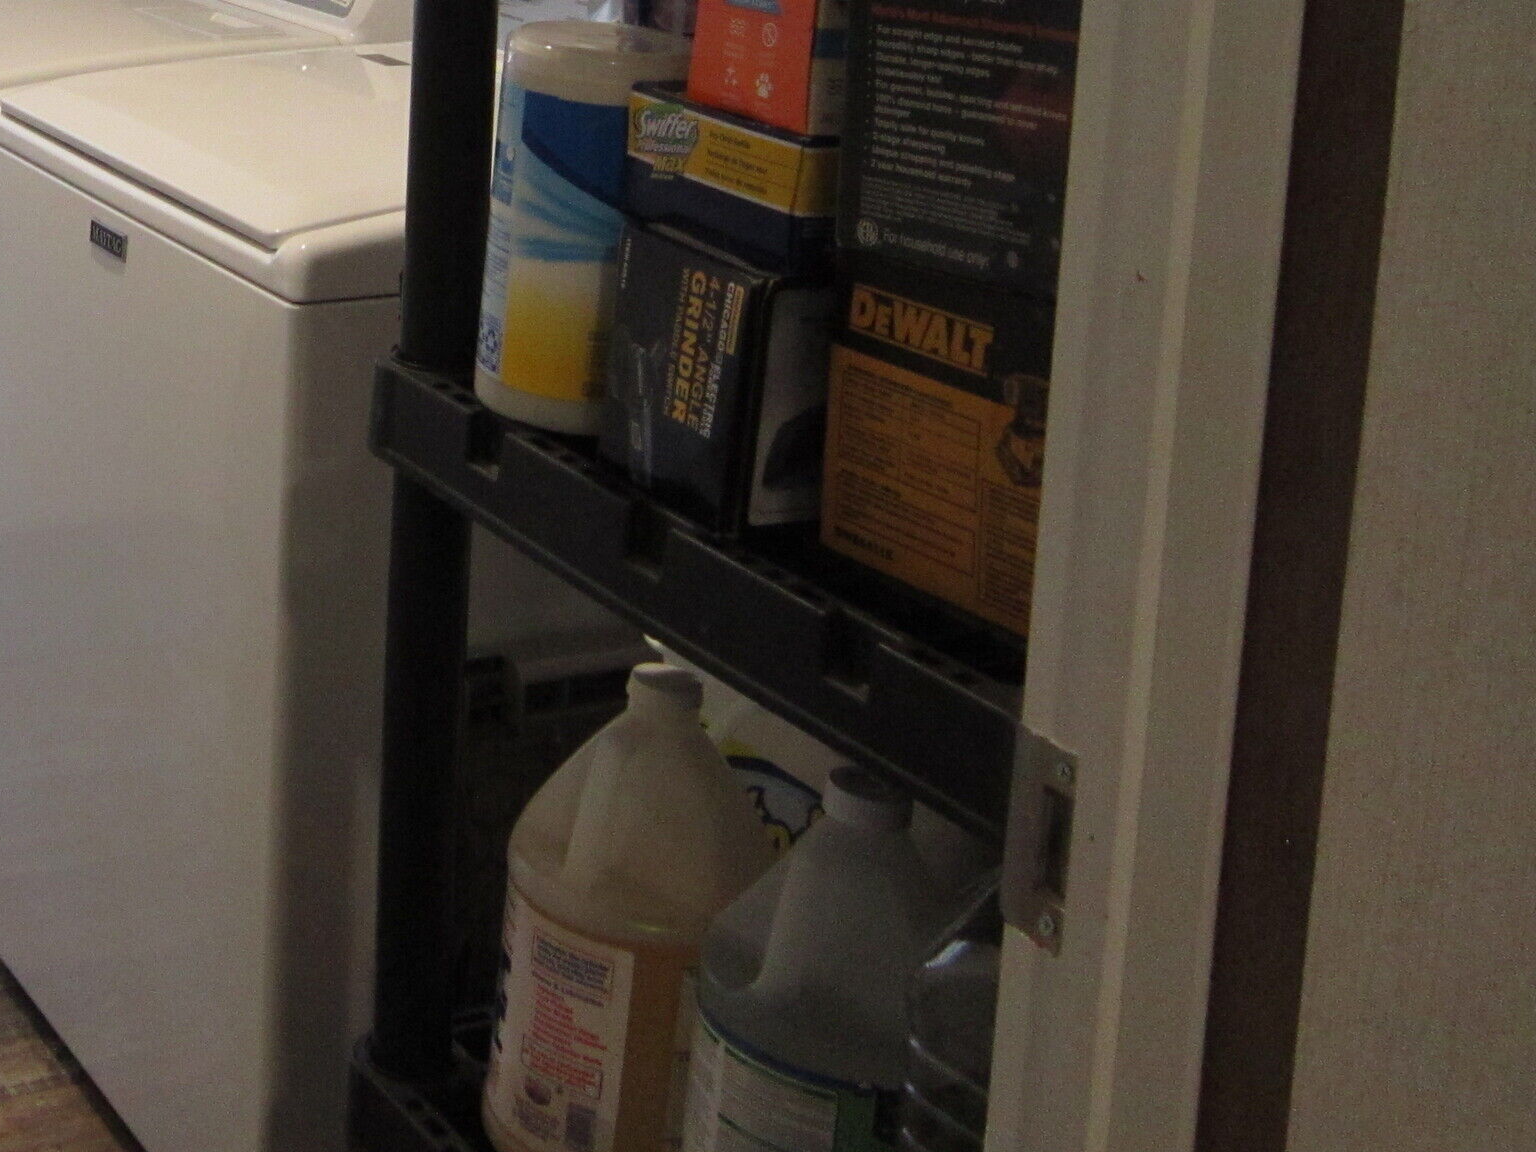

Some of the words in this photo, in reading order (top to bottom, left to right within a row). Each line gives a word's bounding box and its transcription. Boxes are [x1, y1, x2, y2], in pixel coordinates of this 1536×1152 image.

[636, 109, 698, 139] Swiffer
[883, 228, 897, 244] For
[899, 233, 946, 256] household
[671, 270, 707, 424] GRINDER
[718, 281, 736, 352] CHICAGO
[686, 346, 709, 431] ANGLE
